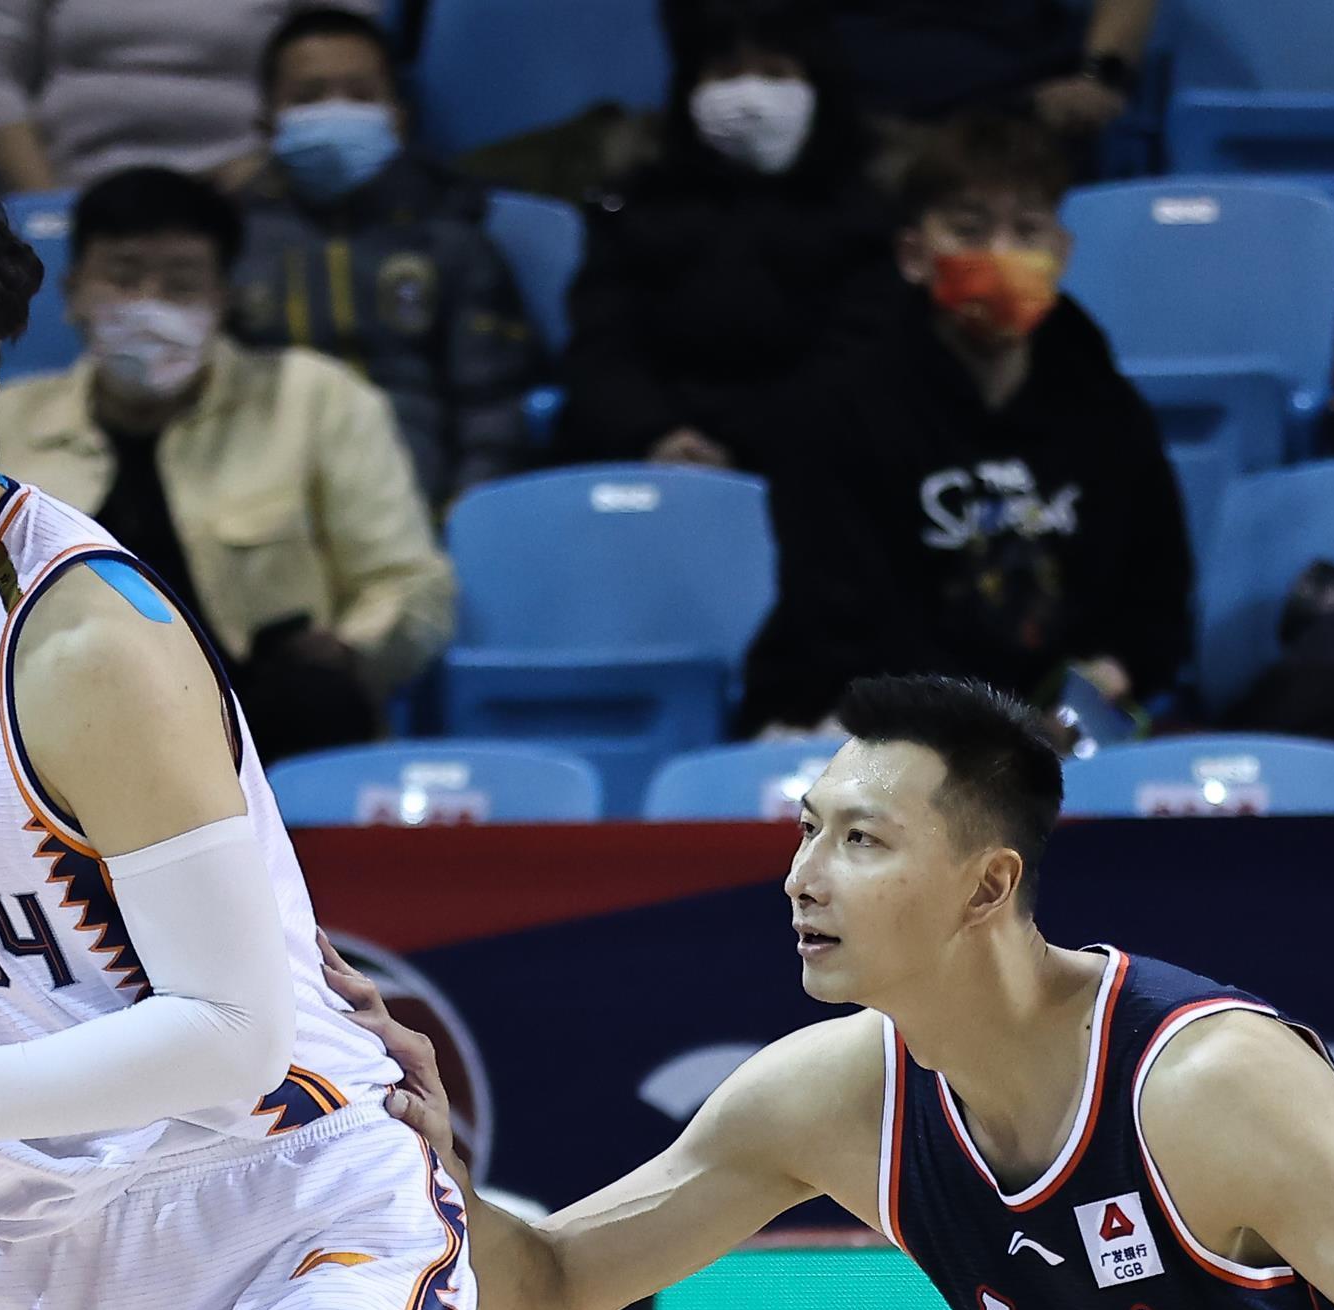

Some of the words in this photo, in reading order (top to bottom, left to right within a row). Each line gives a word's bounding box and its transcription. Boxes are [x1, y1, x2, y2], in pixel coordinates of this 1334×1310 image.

[1100, 1244, 1148, 1267] 广发银行
[1113, 1262, 1144, 1280] CGB
